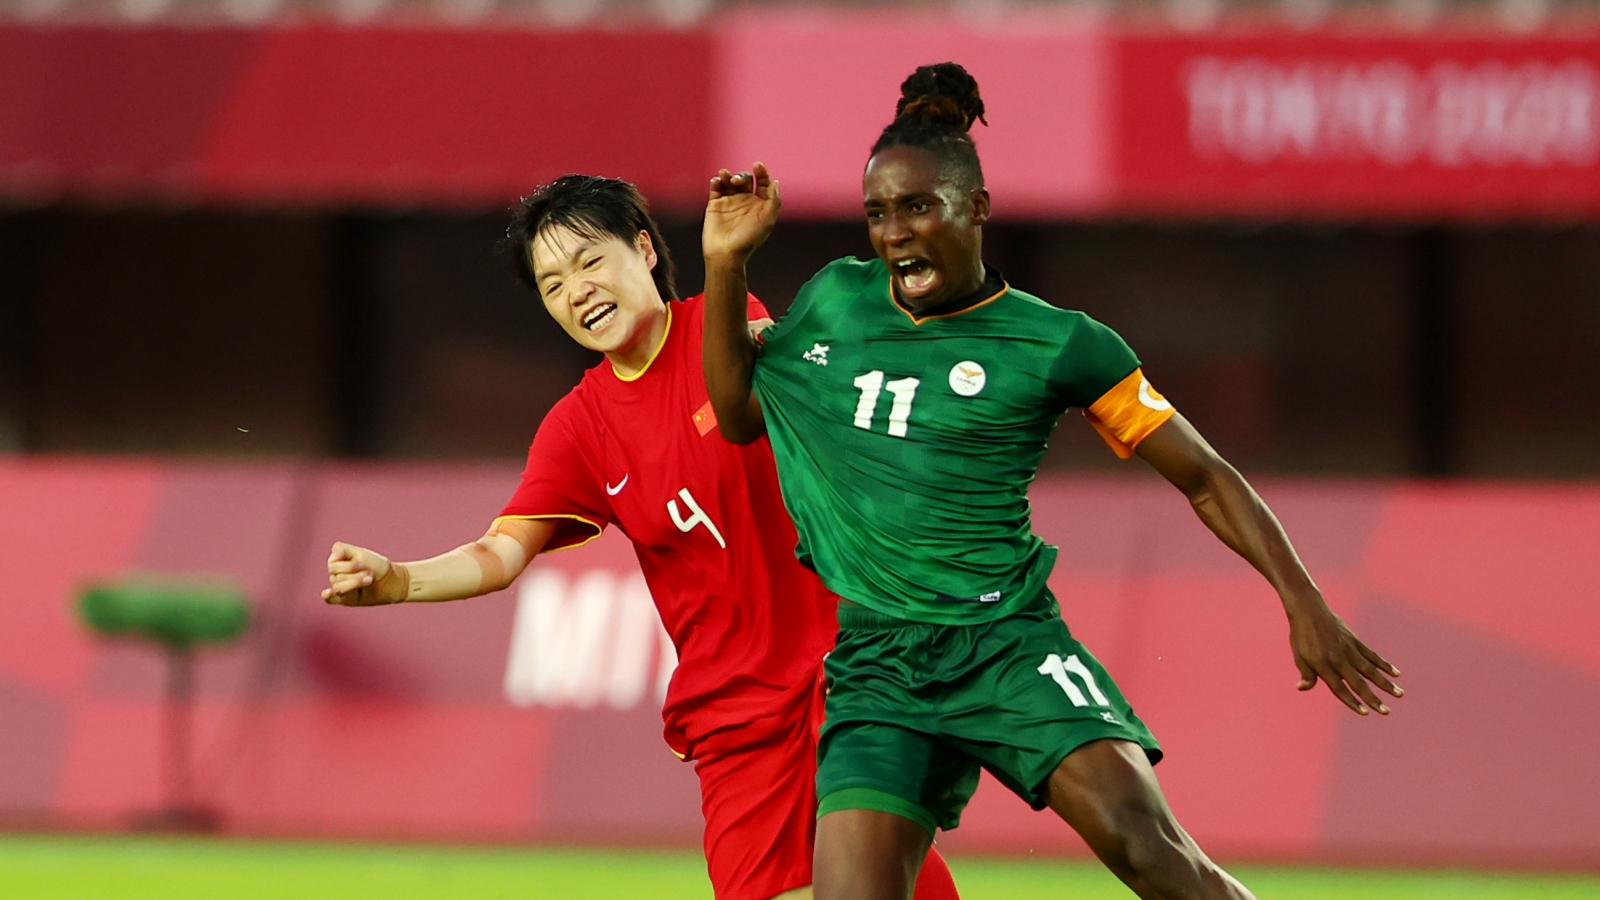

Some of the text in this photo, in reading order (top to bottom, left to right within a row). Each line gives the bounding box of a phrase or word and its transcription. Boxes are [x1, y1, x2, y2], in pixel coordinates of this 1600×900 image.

[853, 370, 920, 438] 11
[666, 487, 726, 549] 4
[1037, 653, 1110, 708] 11
